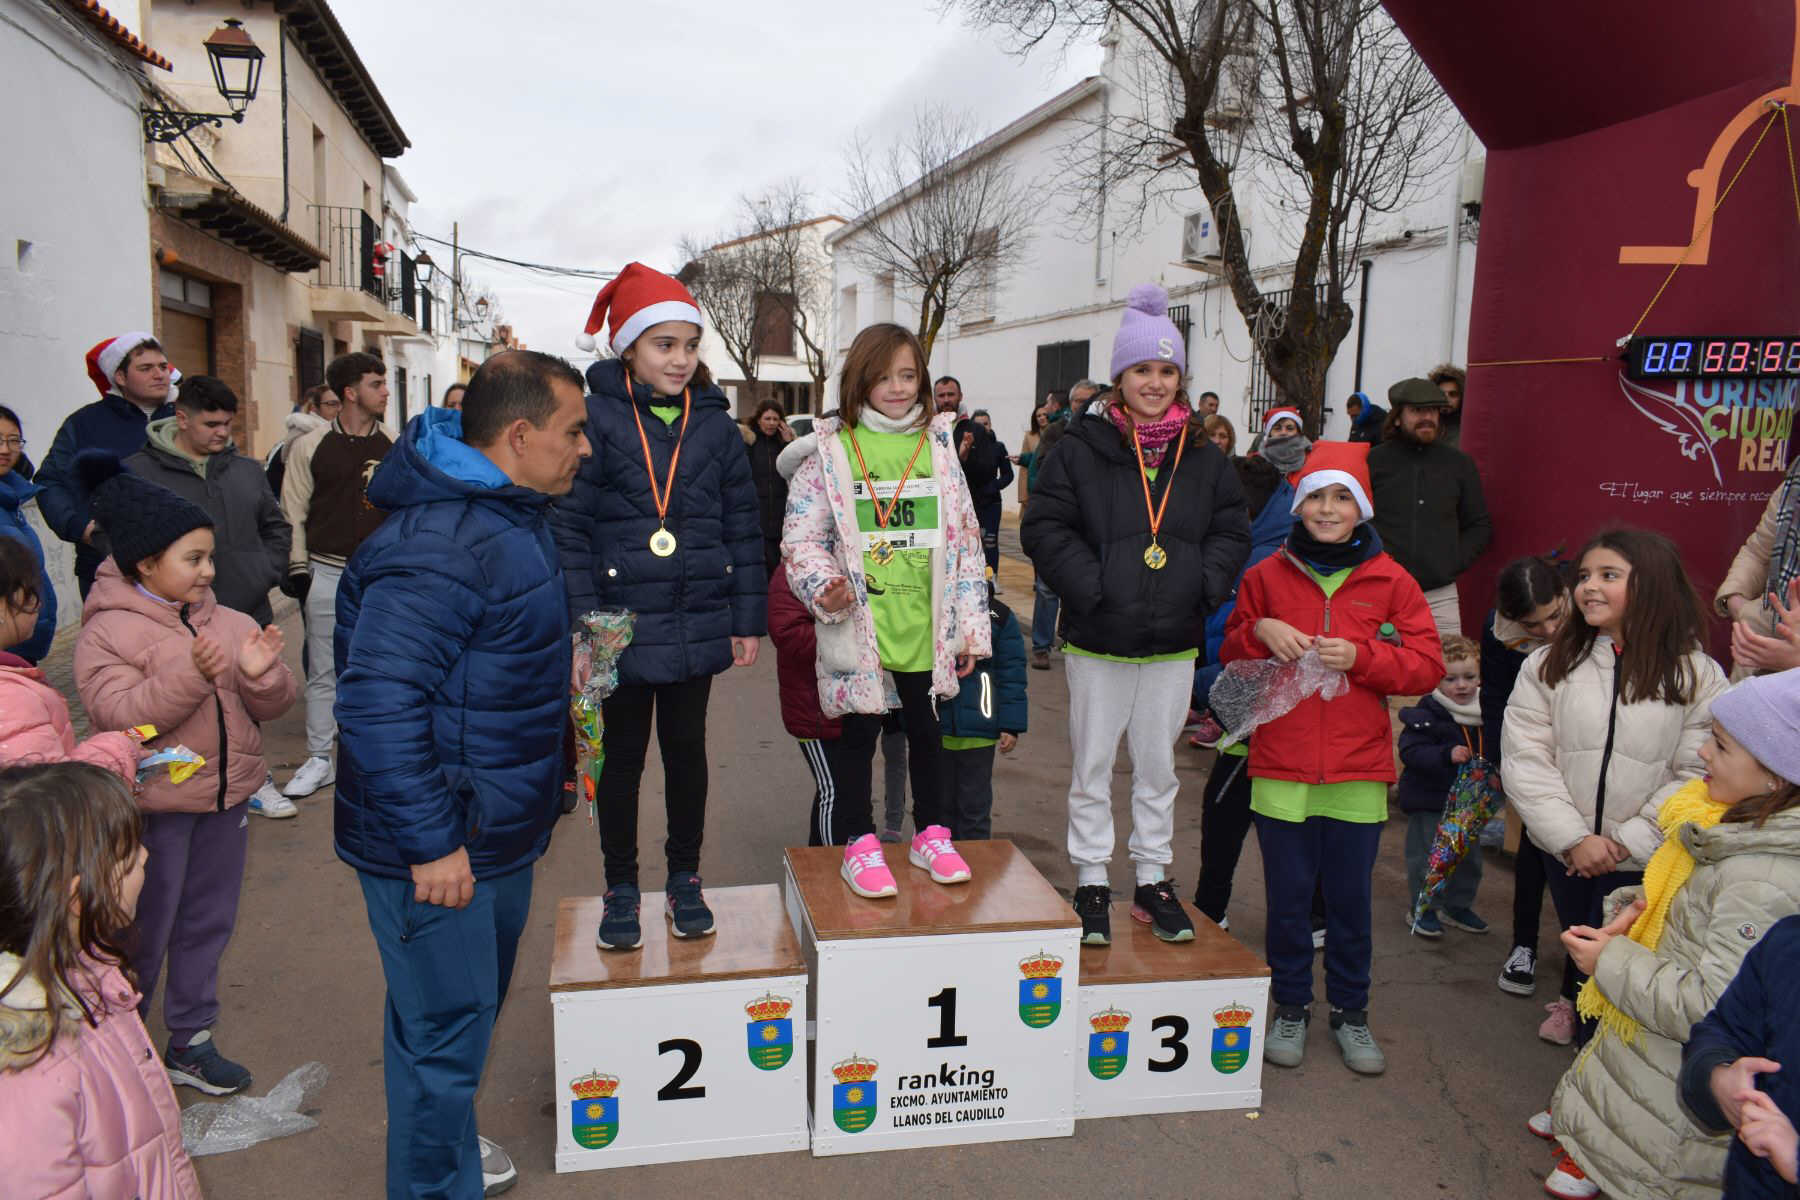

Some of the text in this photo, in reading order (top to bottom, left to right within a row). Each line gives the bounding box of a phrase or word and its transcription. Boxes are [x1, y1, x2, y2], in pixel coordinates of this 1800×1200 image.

[1157, 337, 1174, 359] S
[1632, 482, 1664, 504] lugar
[1670, 490, 1694, 506] que
[1699, 488, 1747, 506] siempre
[927, 987, 967, 1048] 1
[1147, 1015, 1189, 1072] 3
[657, 1038, 706, 1101] 2
[898, 1062, 995, 1090] ranking
[890, 1087, 1008, 1109] EXCMO. AYUNTAMIENTO
[893, 1106, 1005, 1128] LLANOS DEL CAUDILLO
